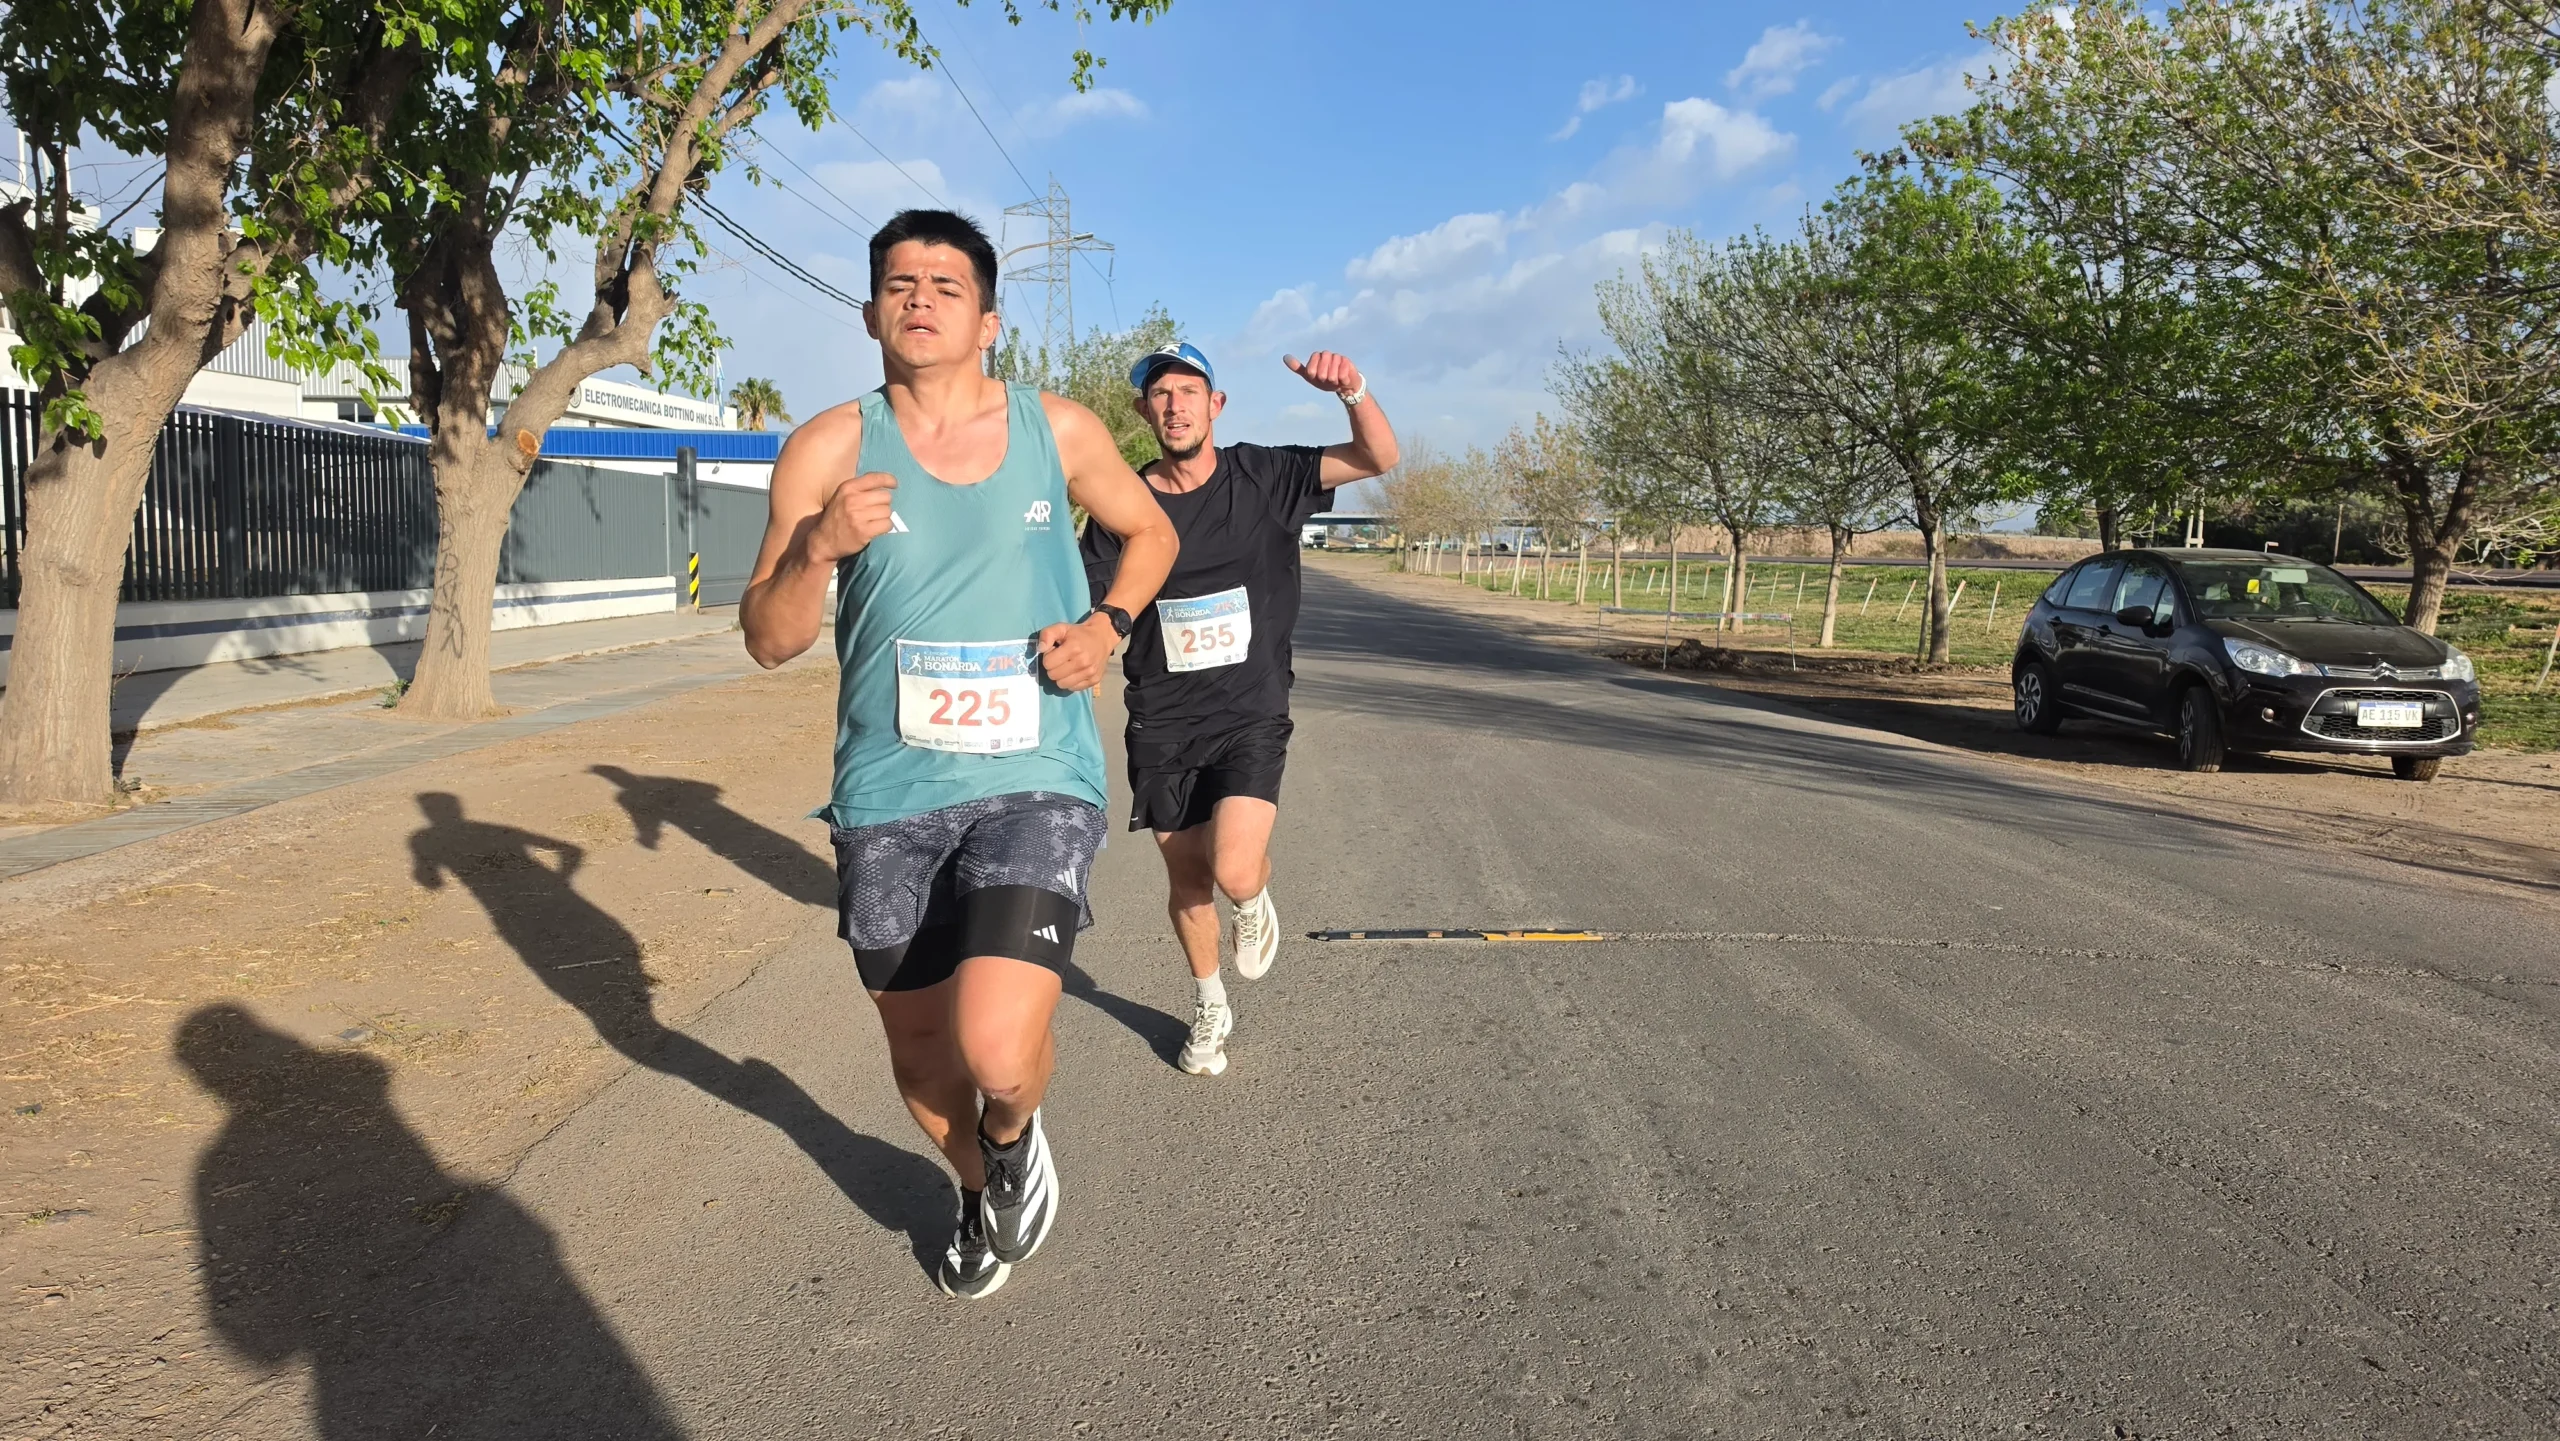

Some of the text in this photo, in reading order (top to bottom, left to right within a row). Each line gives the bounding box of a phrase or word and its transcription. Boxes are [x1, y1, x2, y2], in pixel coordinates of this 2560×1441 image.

[585, 388, 662, 416] ELECTROMECANICA
[664, 404, 694, 421] BOTTINO
[1175, 608, 1212, 618] BONARDA
[1180, 622, 1236, 654] 255
[924, 662, 982, 671] BONARDA
[928, 688, 1011, 727] 225
[2362, 709, 2418, 720] AE 115 VK
